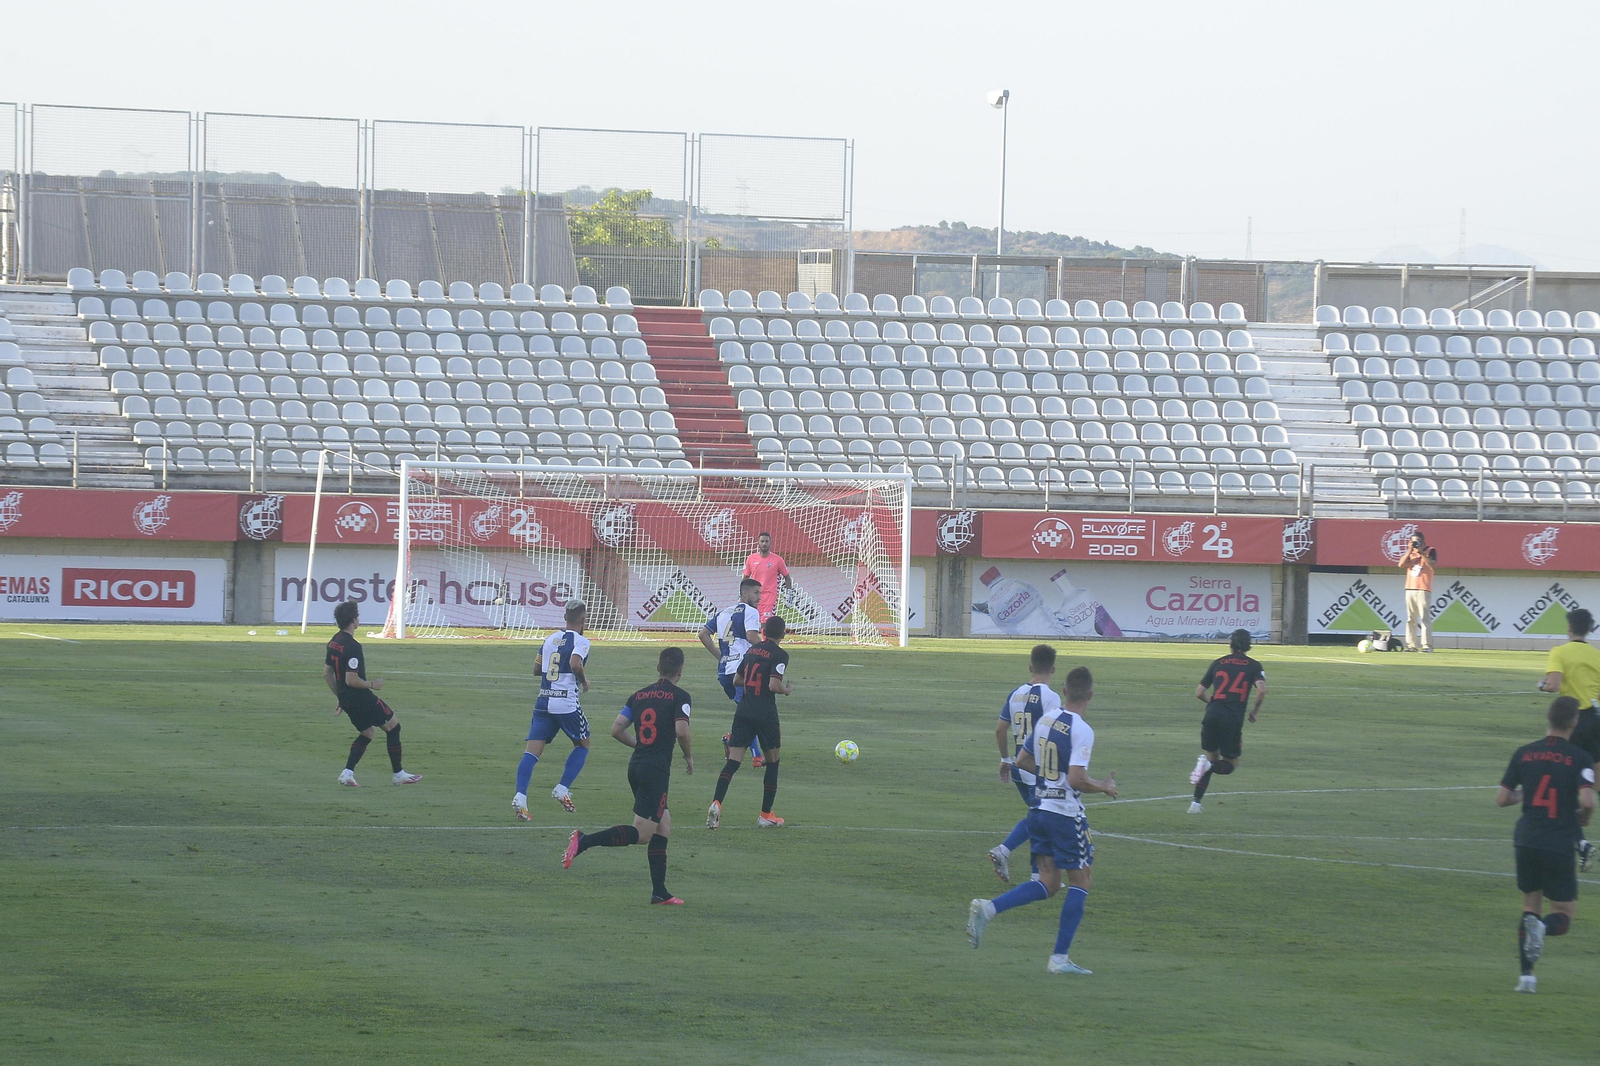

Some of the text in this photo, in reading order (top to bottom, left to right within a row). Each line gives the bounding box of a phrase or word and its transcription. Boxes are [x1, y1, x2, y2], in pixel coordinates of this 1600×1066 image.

[1082, 523, 1146, 536] PLAYOFF
[1088, 544, 1138, 556] 2020
[73, 579, 185, 602] RICOH
[1189, 576, 1232, 589] Sierra
[7, 595, 50, 603] CATALUNYA
[997, 590, 1031, 622] Cazorla
[1066, 600, 1100, 628] Cazorla
[1145, 586, 1260, 613] Cazorla
[1317, 578, 1402, 629] LEROY MERLIN
[1450, 580, 1501, 631] MERLIN
[1512, 591, 1553, 632] LEROY
[723, 620, 735, 646] 4
[1145, 615, 1260, 627] Agua Mineral Natural
[331, 655, 340, 681] 7
[546, 651, 561, 682] 6
[744, 662, 762, 696] 14
[1213, 670, 1249, 703] 24
[639, 707, 658, 745] 8
[1013, 711, 1033, 746] 21
[1038, 736, 1060, 782] 10
[1531, 774, 1556, 818] 4
